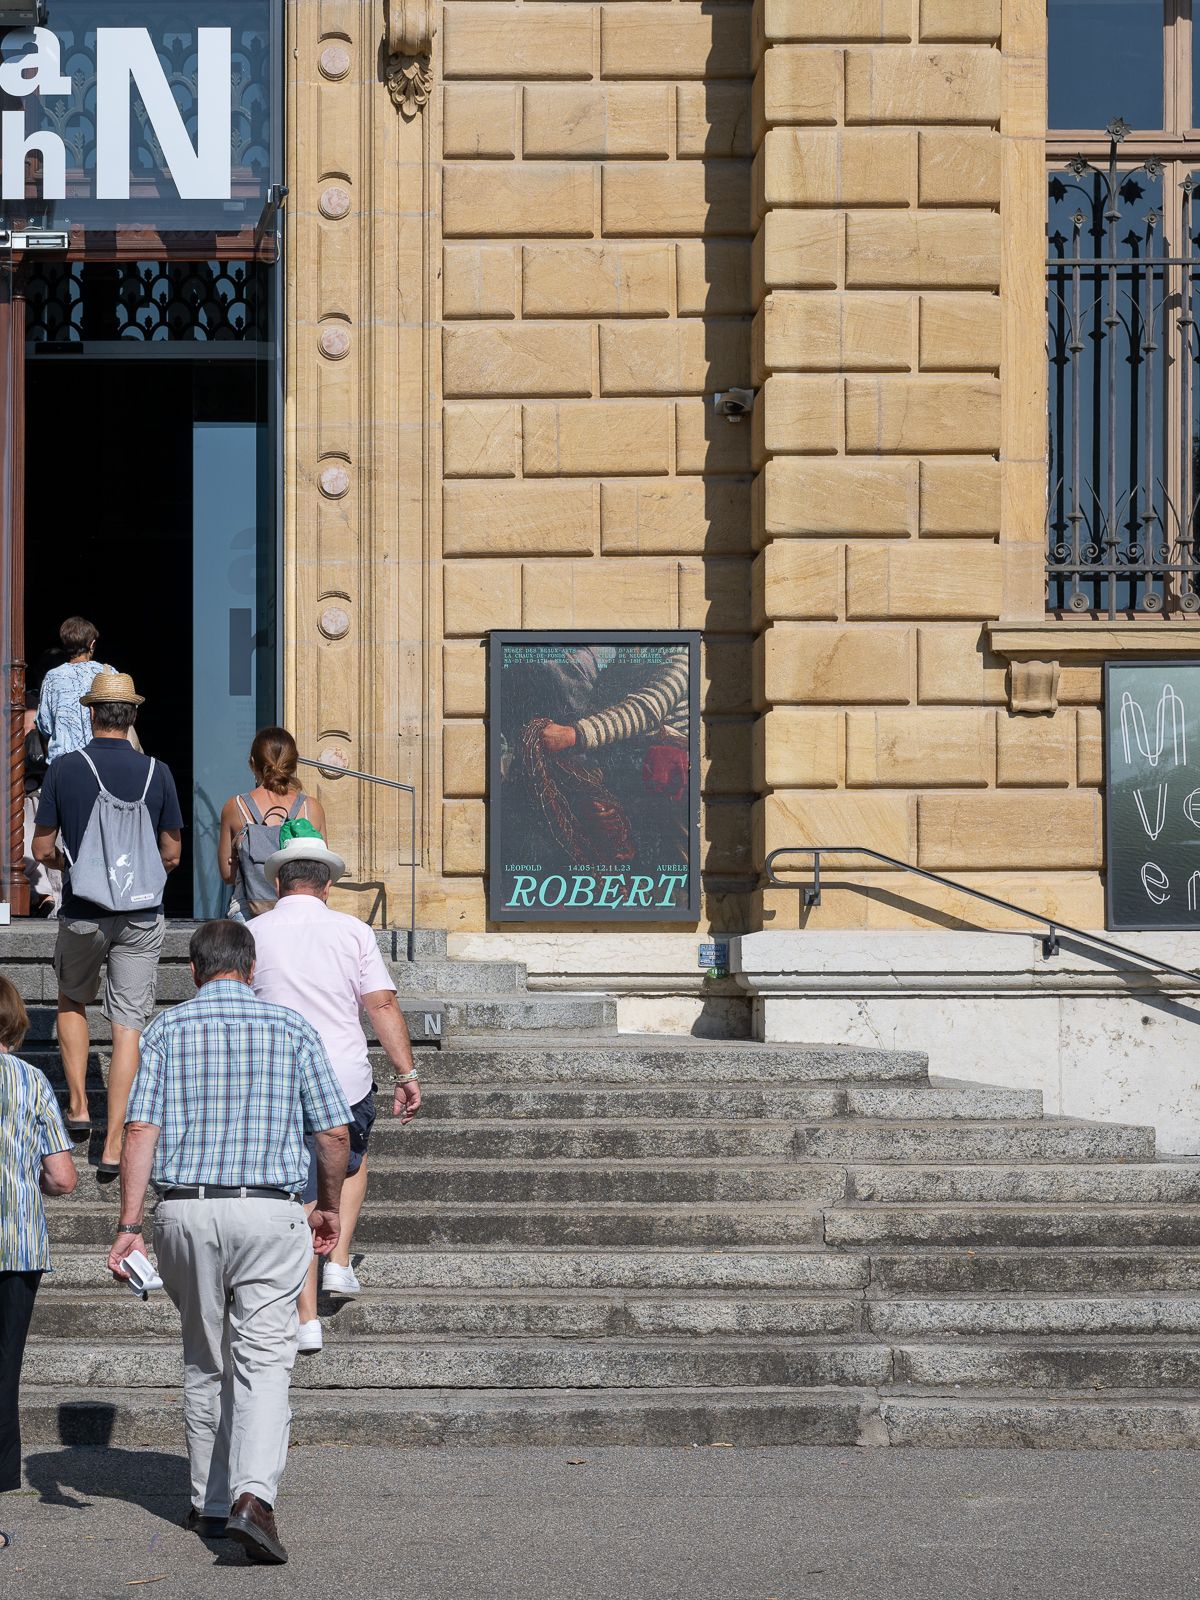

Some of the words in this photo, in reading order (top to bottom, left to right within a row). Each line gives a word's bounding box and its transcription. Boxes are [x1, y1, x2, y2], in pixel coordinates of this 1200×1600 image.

[1120, 684, 1187, 767] M
[504, 863, 542, 872] LÉOPOLD
[656, 863, 688, 872] AURÈLE
[504, 874, 687, 910] ROBERT
[424, 1013, 441, 1036] N
